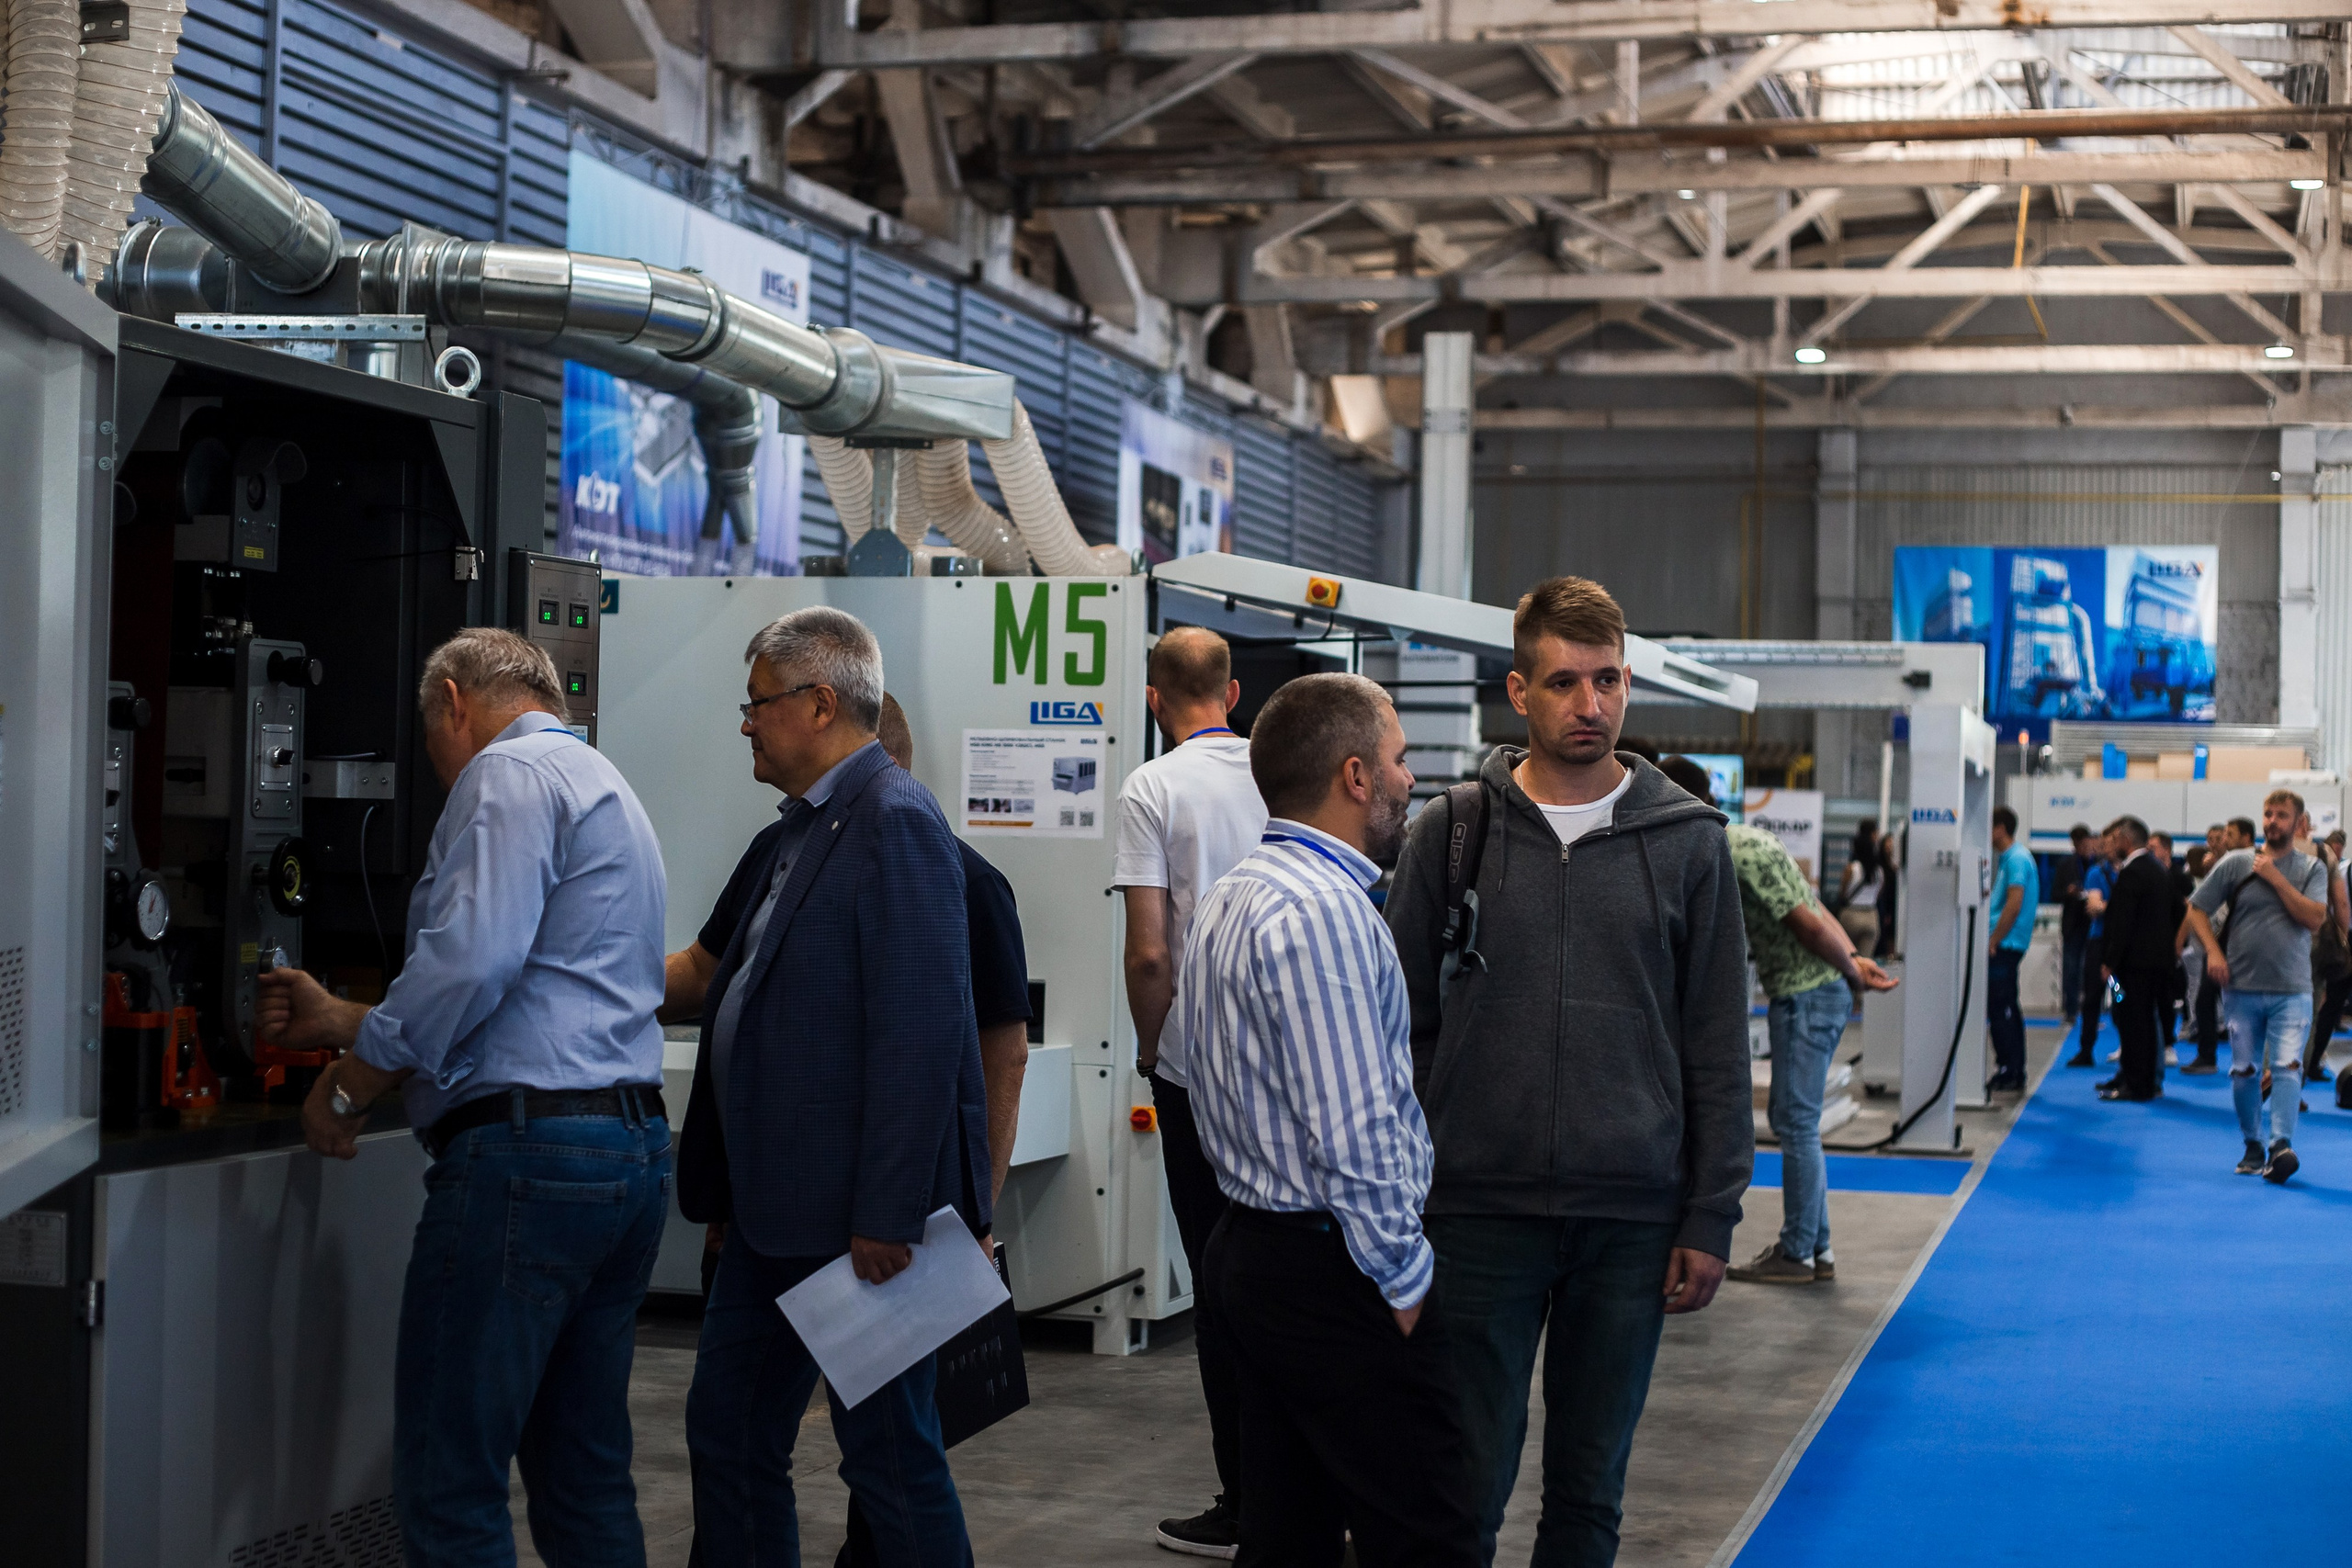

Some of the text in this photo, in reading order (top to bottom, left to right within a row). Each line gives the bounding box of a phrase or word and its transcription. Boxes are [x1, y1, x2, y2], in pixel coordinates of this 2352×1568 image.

[993, 581, 1108, 686] M5
[1030, 701, 1104, 725] LIGA
[1912, 808, 1958, 824] LIGA
[1448, 822, 1467, 884] OGIO
